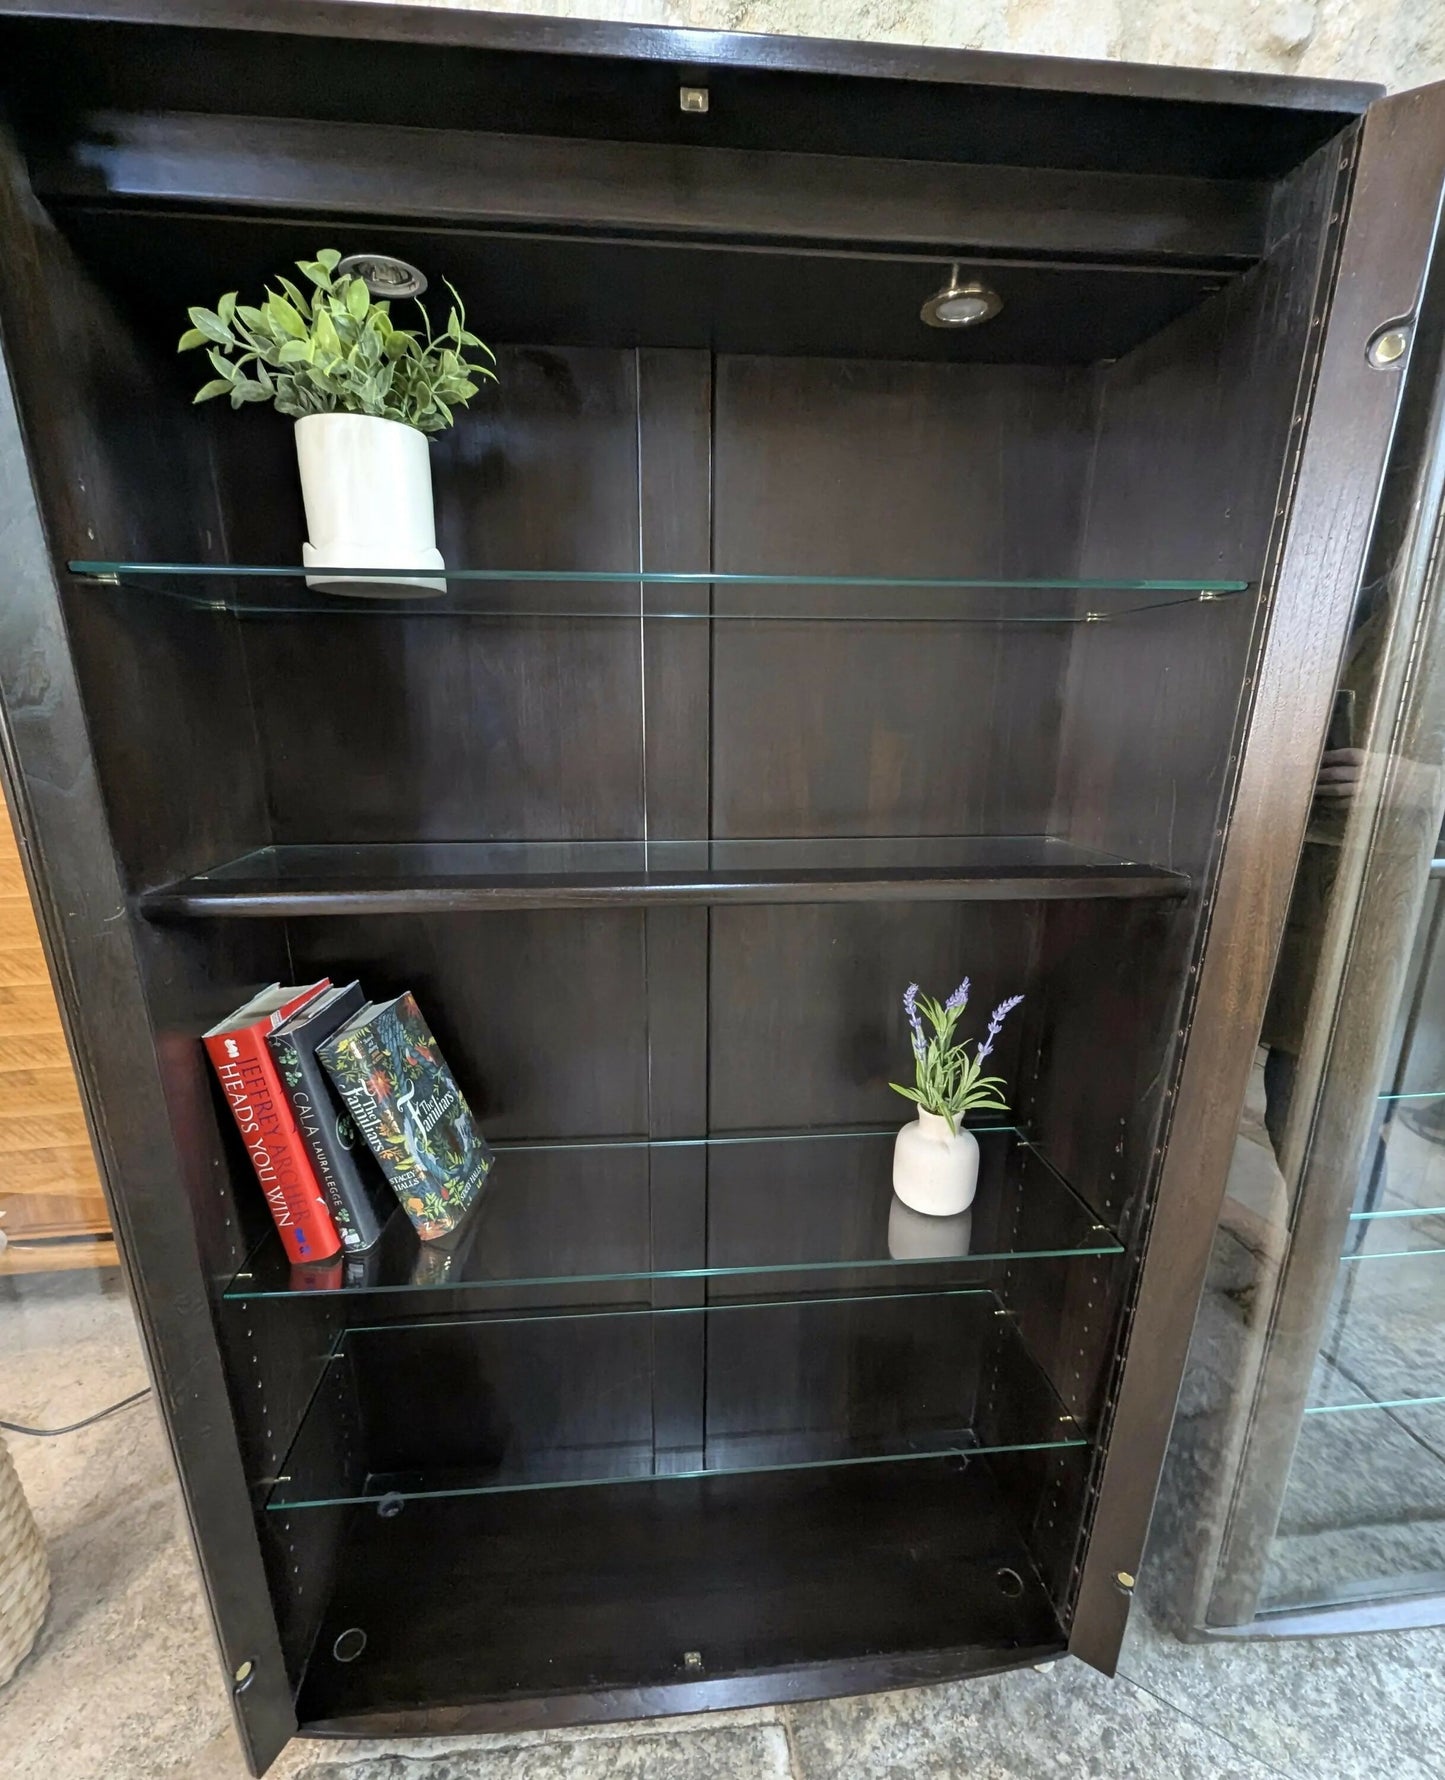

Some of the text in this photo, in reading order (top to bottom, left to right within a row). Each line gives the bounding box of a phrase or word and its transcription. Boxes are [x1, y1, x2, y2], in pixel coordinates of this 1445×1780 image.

[293, 1092, 319, 1137] CALA
[339, 1078, 385, 1152] Familiars
[363, 1096, 378, 1120] The
[397, 1078, 454, 1153] Familiars
[419, 1099, 434, 1115] The
[218, 1062, 294, 1227] HEADS YOU WIN
[237, 1057, 310, 1224] JEFFREY ARCHER
[312, 1140, 342, 1206] LAURA LEGGE
[390, 1169, 416, 1185] STACEY
[394, 1178, 420, 1192] HALLS
